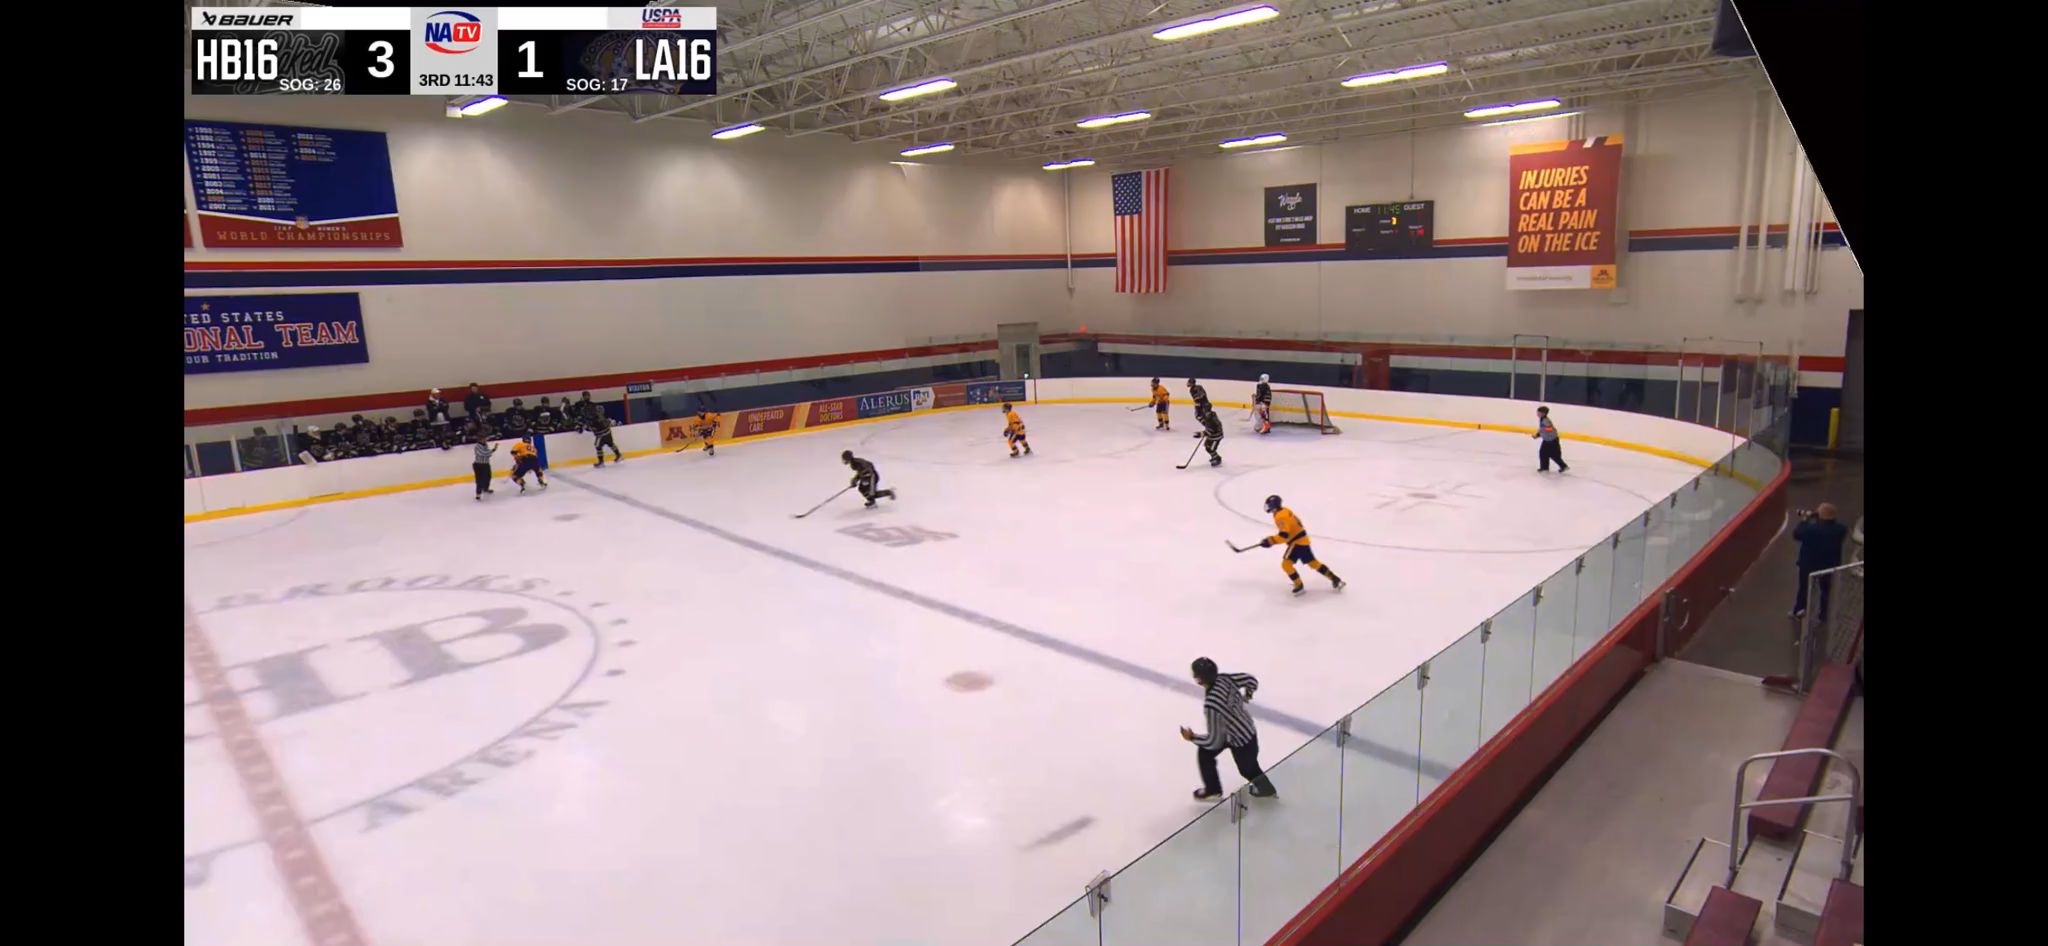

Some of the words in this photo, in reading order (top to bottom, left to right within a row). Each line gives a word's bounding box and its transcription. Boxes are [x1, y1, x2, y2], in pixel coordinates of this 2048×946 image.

[1519, 166, 1589, 189] INJURIES
[1519, 190, 1551, 211] CAN
[1552, 189, 1574, 208] BE
[1575, 187, 1587, 208] A
[1518, 212, 1554, 232] REAL
[1558, 209, 1598, 230] PAIN
[217, 231, 268, 241] WORLD
[277, 231, 389, 242] CHAMPIONSHIPS
[1517, 234, 1541, 253] ON
[1544, 233, 1573, 251] THE
[1574, 231, 1601, 250] ICE
[221, 311, 284, 323] STATES
[275, 321, 359, 347] TEAM
[216, 352, 278, 363] TRADITION
[819, 402, 843, 413] ALL-STAR
[860, 393, 910, 410] ALERUS
[747, 410, 784, 422] UNDEFEATED
[819, 412, 843, 422] DOCTORS
[748, 421, 764, 433] CARE
